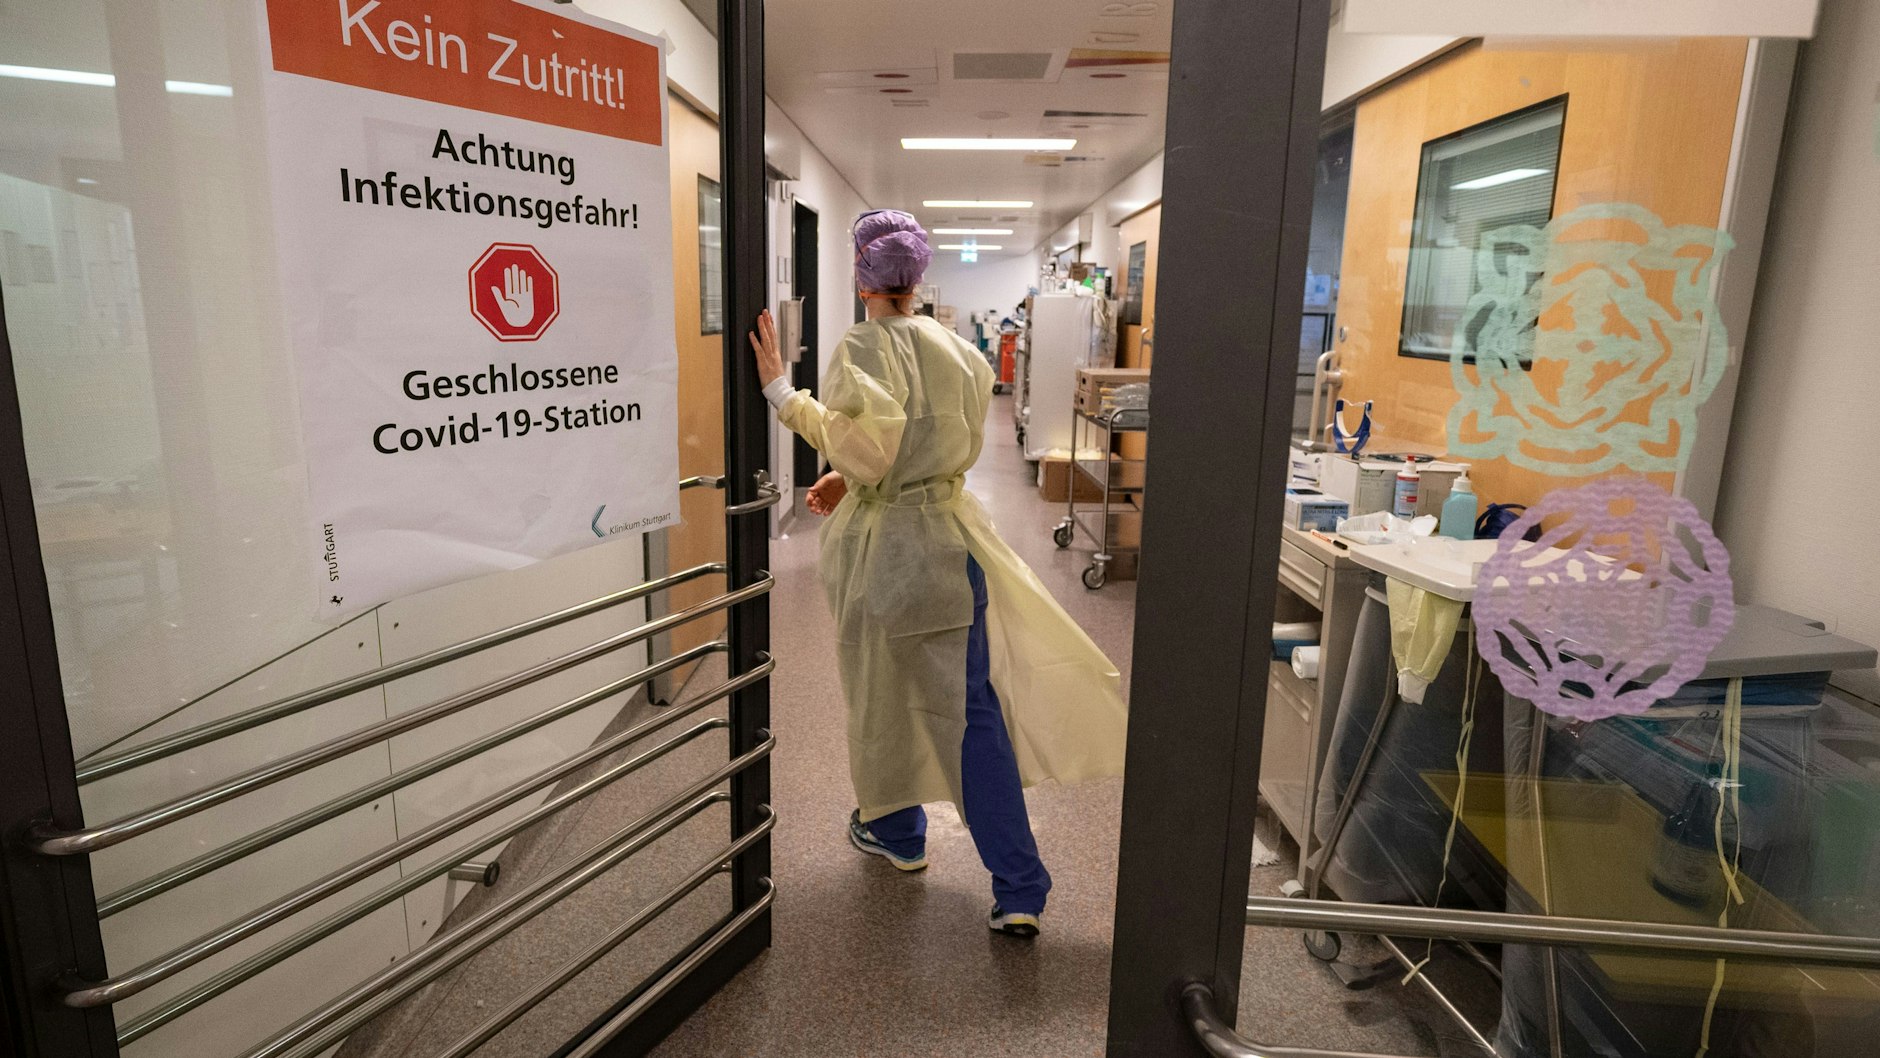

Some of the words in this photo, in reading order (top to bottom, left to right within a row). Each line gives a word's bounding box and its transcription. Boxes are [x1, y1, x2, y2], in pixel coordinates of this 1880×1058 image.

[338, 0, 468, 74] Kein
[487, 32, 626, 110] Zutritt!
[432, 129, 575, 186] Achtung
[340, 168, 639, 229] Infektionsgefahr!
[402, 363, 619, 401] Geschlossene
[373, 401, 642, 455] Covid-19-Station
[324, 523, 340, 582] STUTTGART
[609, 520, 641, 536] Klinikum
[642, 512, 671, 528] Stuttgart
